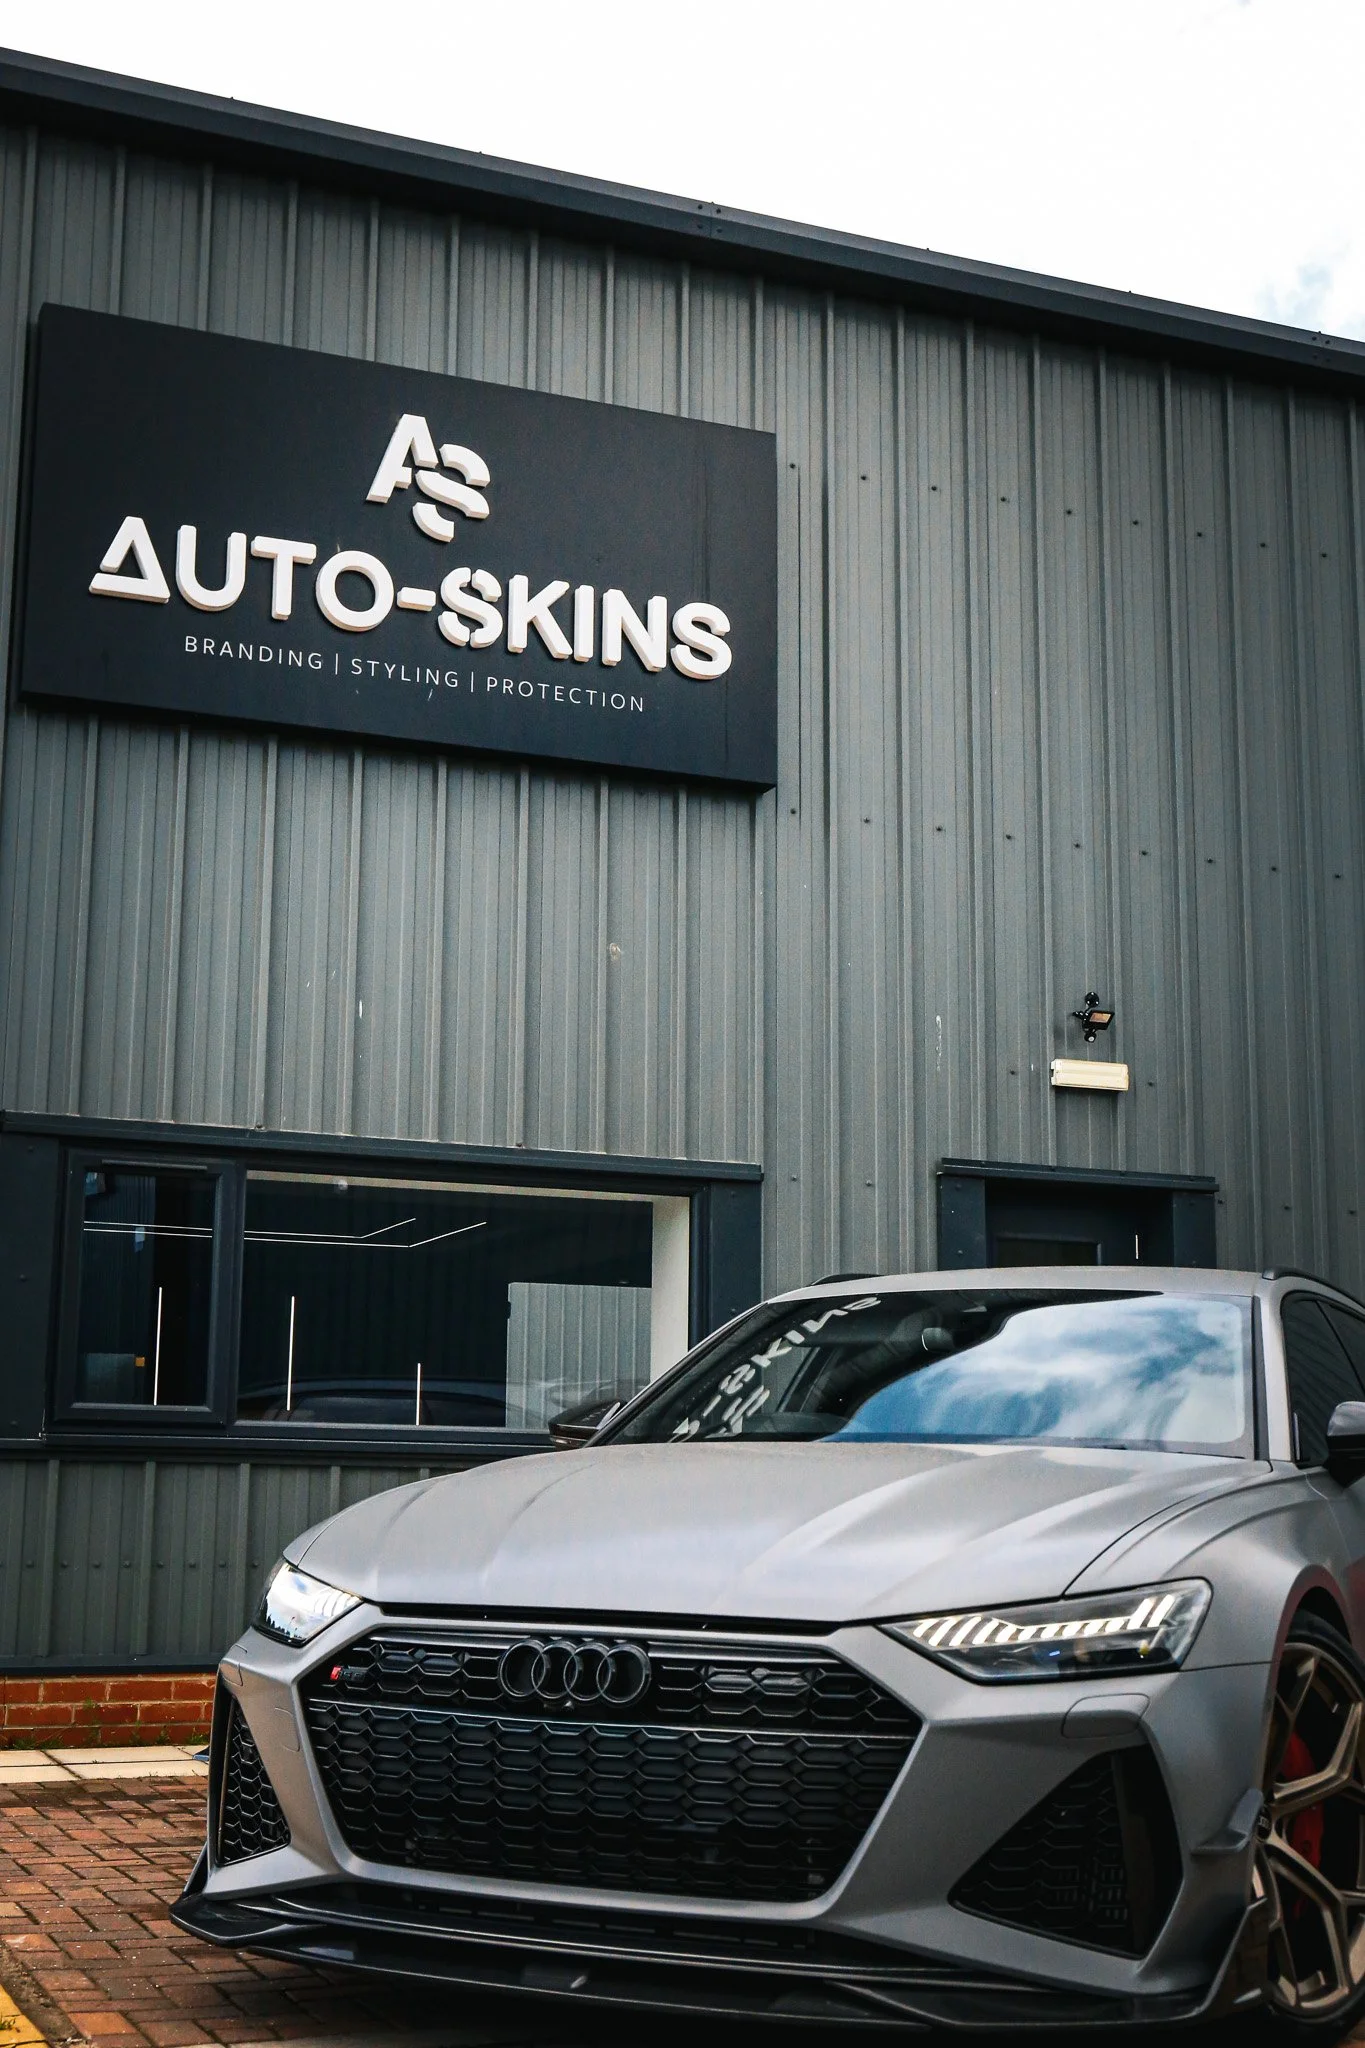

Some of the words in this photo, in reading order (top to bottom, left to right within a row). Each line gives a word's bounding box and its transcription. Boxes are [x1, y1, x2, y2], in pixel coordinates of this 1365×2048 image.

[366, 413, 491, 543] AS
[88, 515, 733, 680] AUTO-SKINS
[184, 635, 323, 670] BRANDING
[350, 657, 459, 688] STYLING
[485, 675, 645, 713] PROTECTION
